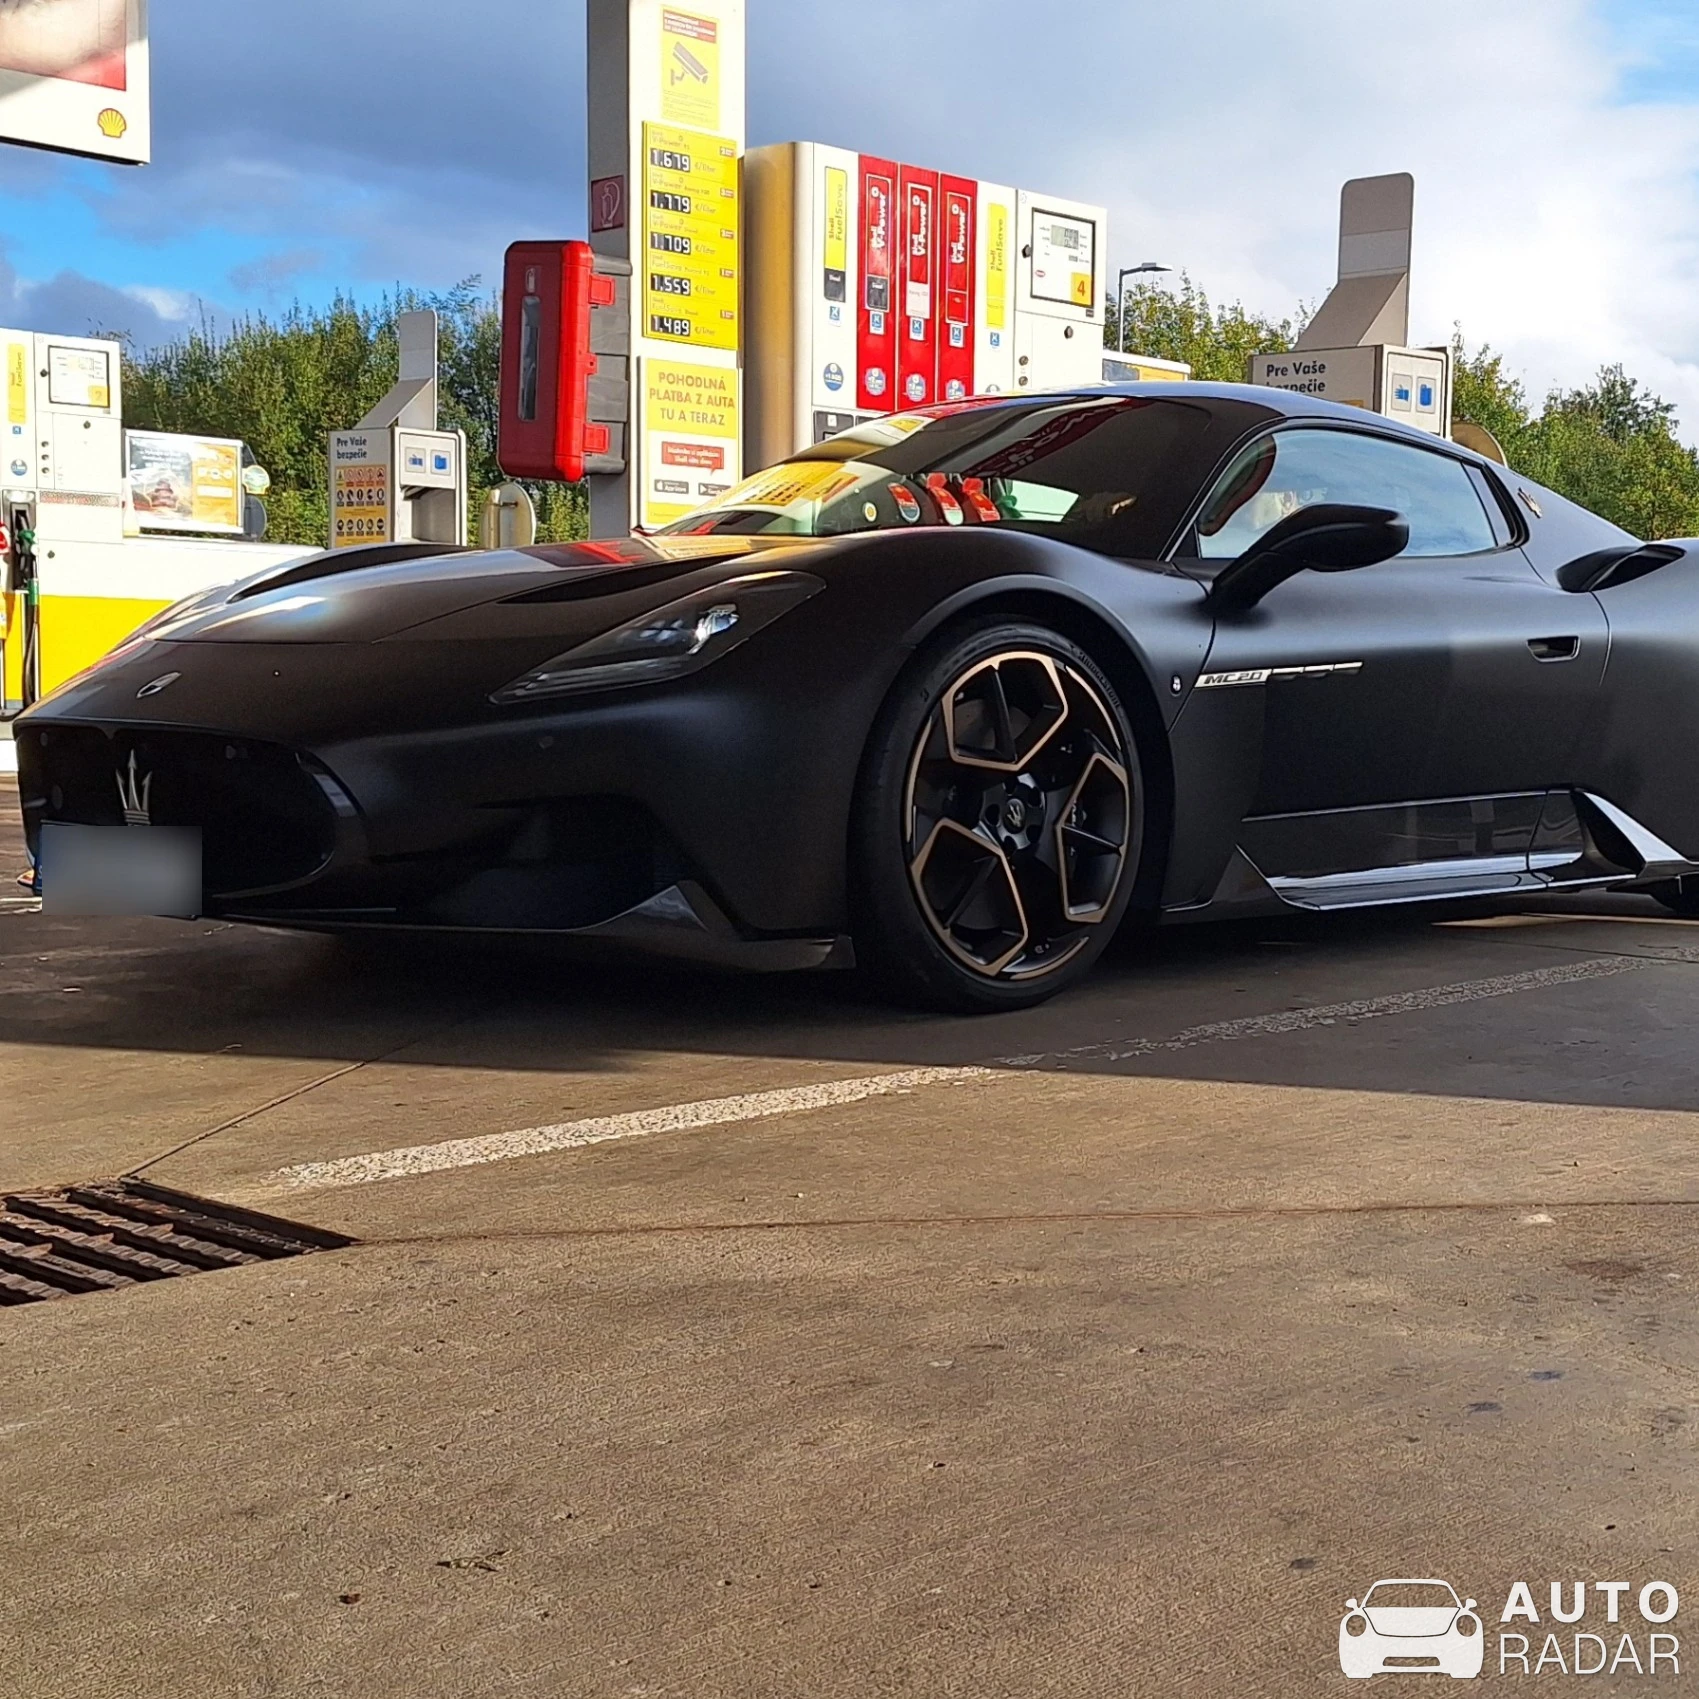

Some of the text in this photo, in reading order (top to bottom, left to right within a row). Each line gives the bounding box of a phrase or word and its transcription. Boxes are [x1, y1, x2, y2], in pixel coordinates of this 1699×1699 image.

[652, 150, 689, 171] 1.679
[652, 192, 690, 212] 1.779
[834, 184, 844, 241] FuelSave
[877, 192, 887, 248] V-Power
[918, 201, 927, 256] V-Power
[957, 209, 966, 264] V-Power
[653, 233, 690, 254] 1.709
[996, 218, 1004, 272] FuelSave
[653, 275, 690, 295] 1.559
[1076, 280, 1086, 296] 4
[653, 316, 689, 335] 1.489
[1266, 360, 1326, 377] Pre Vaše
[658, 372, 726, 390] POHODLNÁ
[650, 388, 735, 408] PLATBA Z AUTA
[660, 408, 725, 426] TU A TERAZ
[336, 437, 348, 447] Pre
[1204, 671, 1263, 684] MC20
